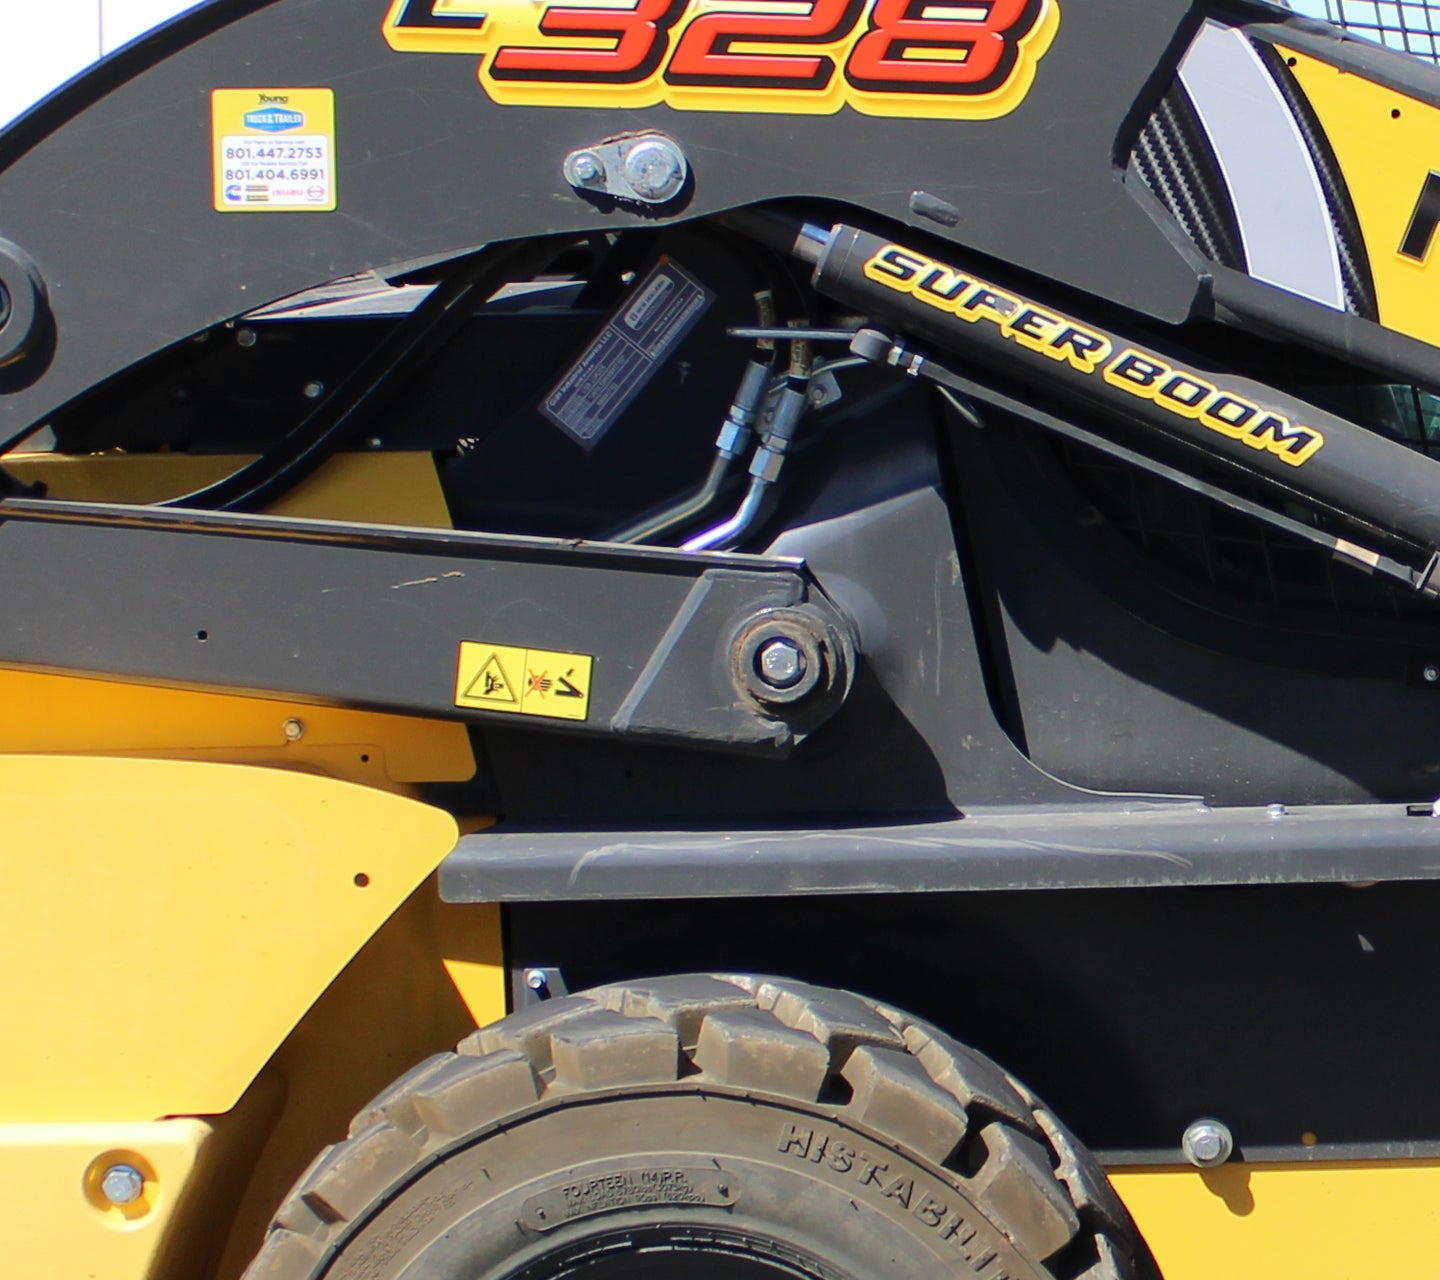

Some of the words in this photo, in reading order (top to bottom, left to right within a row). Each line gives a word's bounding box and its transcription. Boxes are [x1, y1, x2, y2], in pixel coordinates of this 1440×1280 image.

[226, 147, 323, 159] 801.447.2753
[225, 169, 325, 181] 801.404.6991
[1102, 347, 1325, 468] BOOM
[562, 1174, 633, 1198] FOURTEEN
